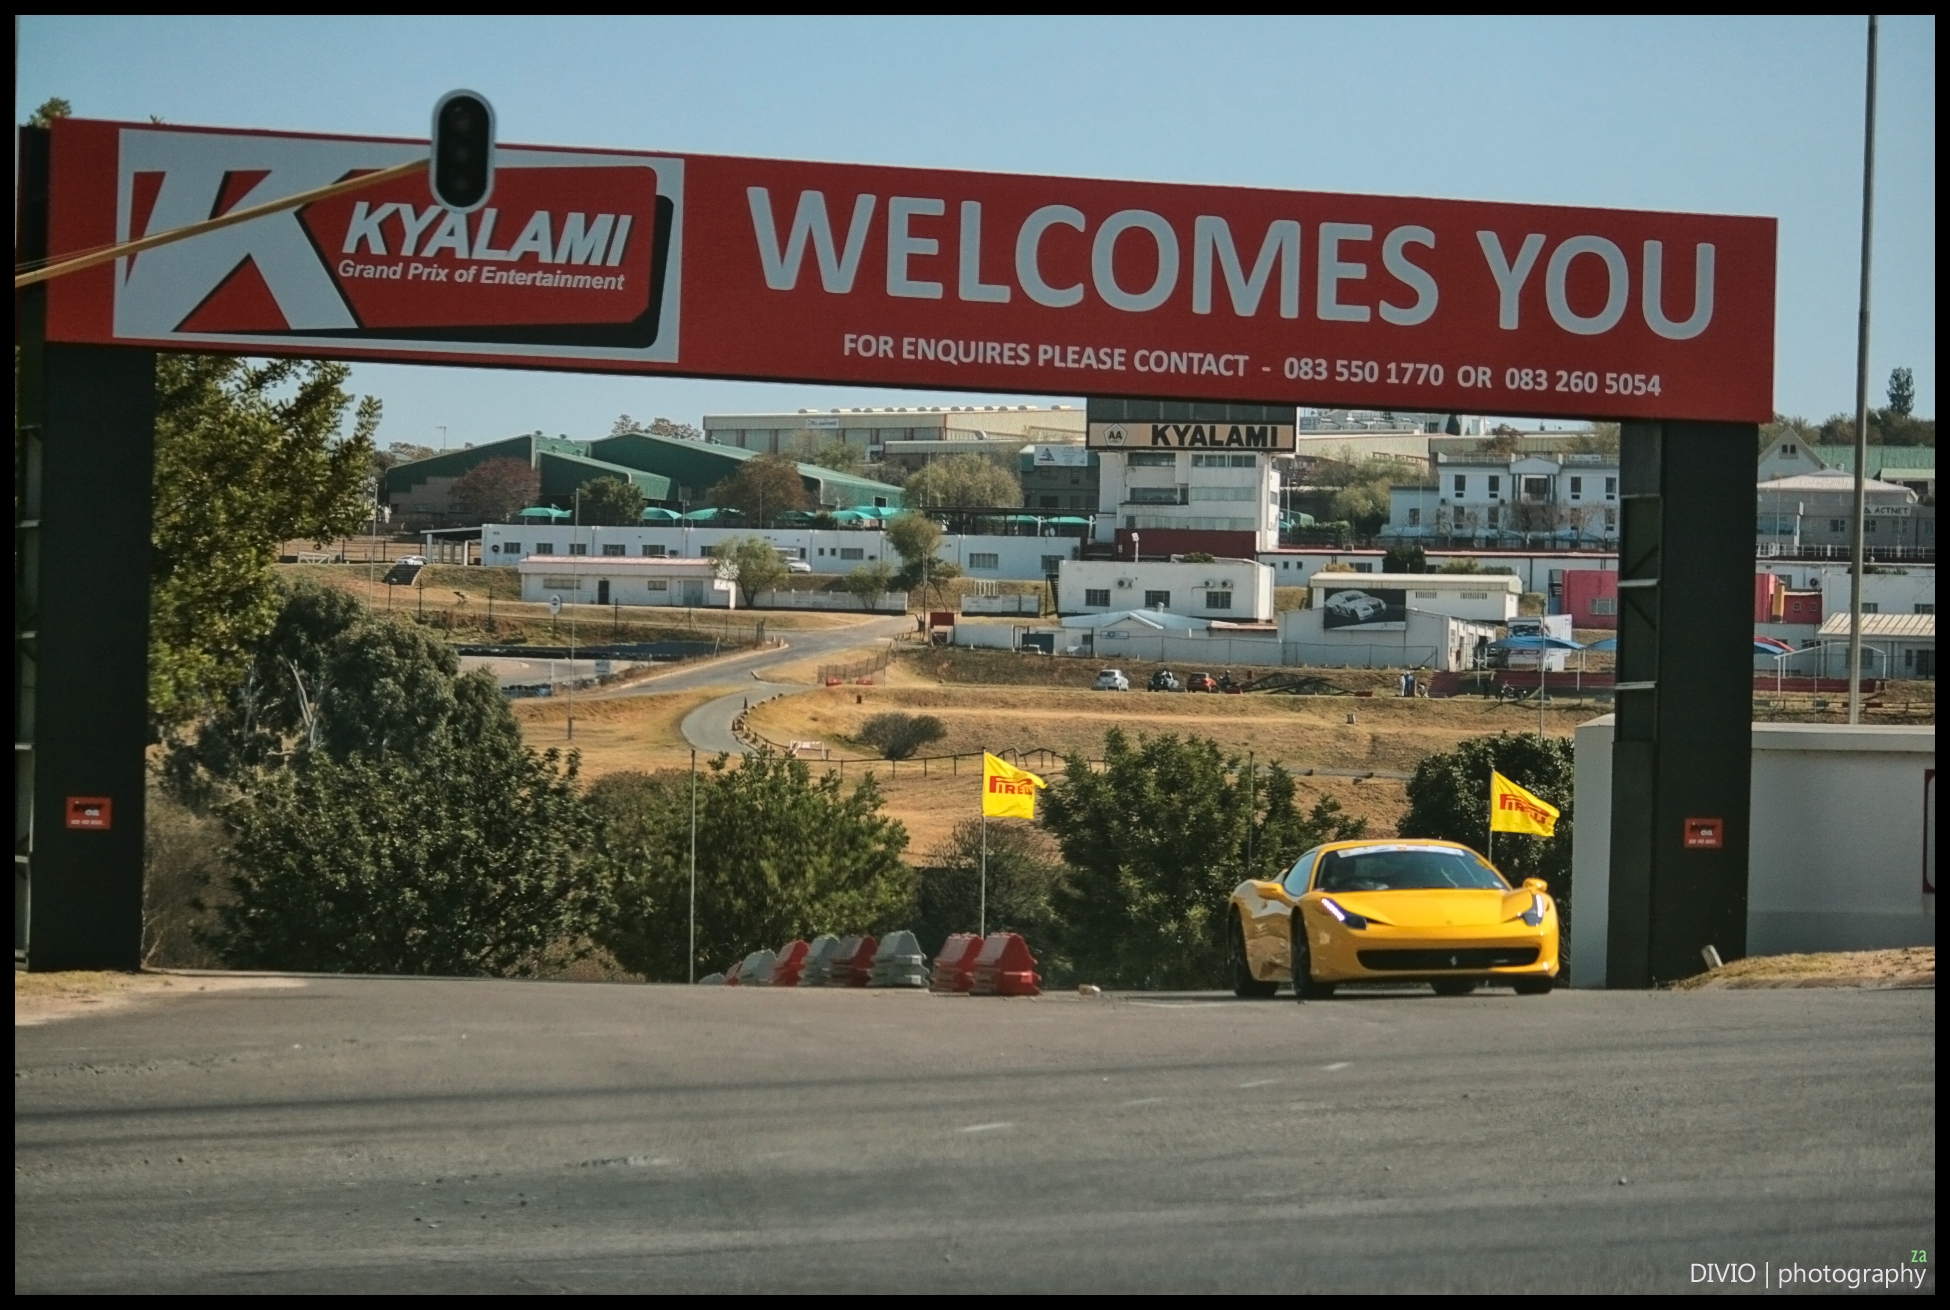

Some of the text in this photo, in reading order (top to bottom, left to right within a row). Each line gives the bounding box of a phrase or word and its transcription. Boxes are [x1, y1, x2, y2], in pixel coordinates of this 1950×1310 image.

[341, 201, 633, 267] KYALAMI
[338, 259, 625, 291] Grand Prix of Entertainment
[745, 186, 1717, 340] WELCOMES YOU
[843, 333, 895, 358] FOR
[902, 337, 1031, 366] ENQUIRES
[1038, 344, 1127, 371] PLEASE
[1133, 349, 1250, 377] CONTACT
[1284, 357, 1328, 381] 083
[1335, 359, 1379, 383] 550
[1386, 362, 1444, 386] 1770
[1457, 365, 1492, 389] OR
[1505, 367, 1548, 391] 083
[1555, 370, 1598, 394] 260
[1604, 372, 1662, 397] 5054
[1108, 430, 1123, 440] AA
[1151, 424, 1278, 448] KYALAMI
